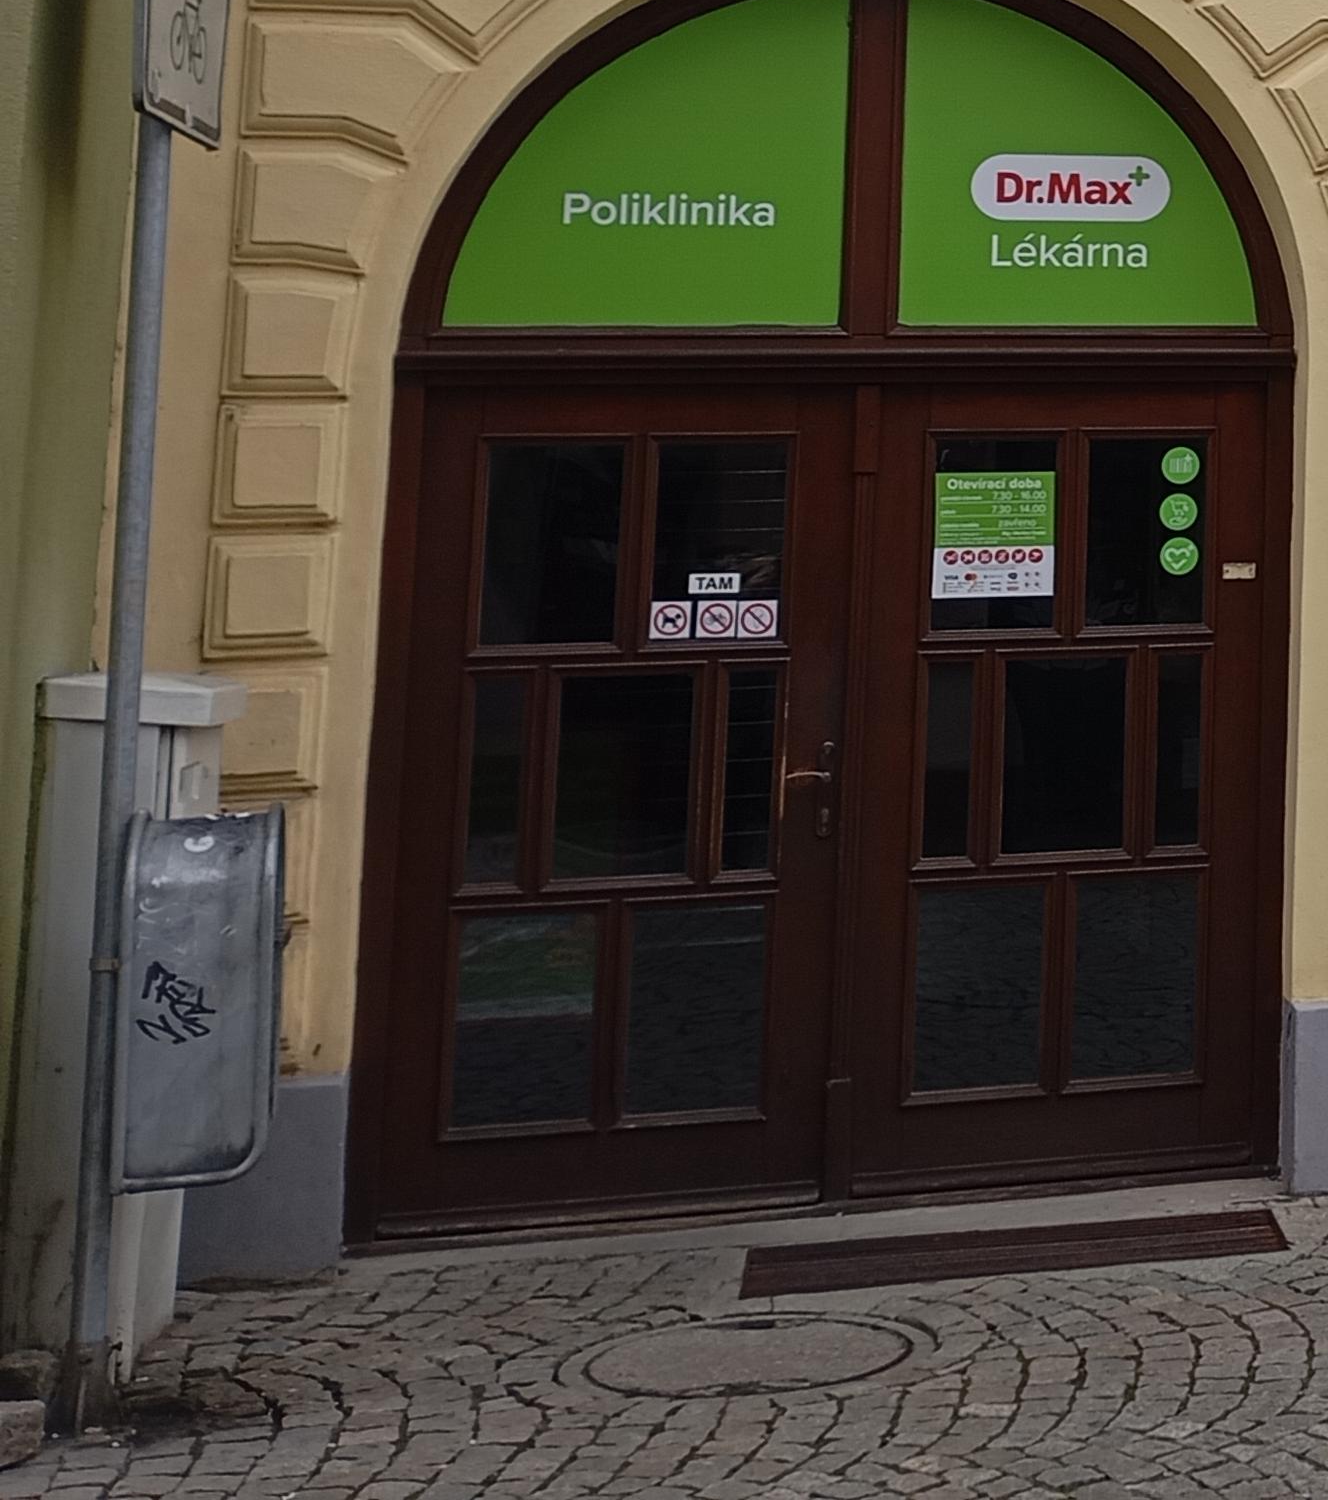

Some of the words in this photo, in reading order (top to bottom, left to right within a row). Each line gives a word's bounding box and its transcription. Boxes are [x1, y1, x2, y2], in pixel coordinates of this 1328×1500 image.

[562, 191, 777, 229] Poliklinika
[990, 232, 1149, 269] Lékárna
[947, 477, 1006, 490] Otevírací
[1009, 477, 1042, 489] doba
[694, 576, 734, 591] TAM
